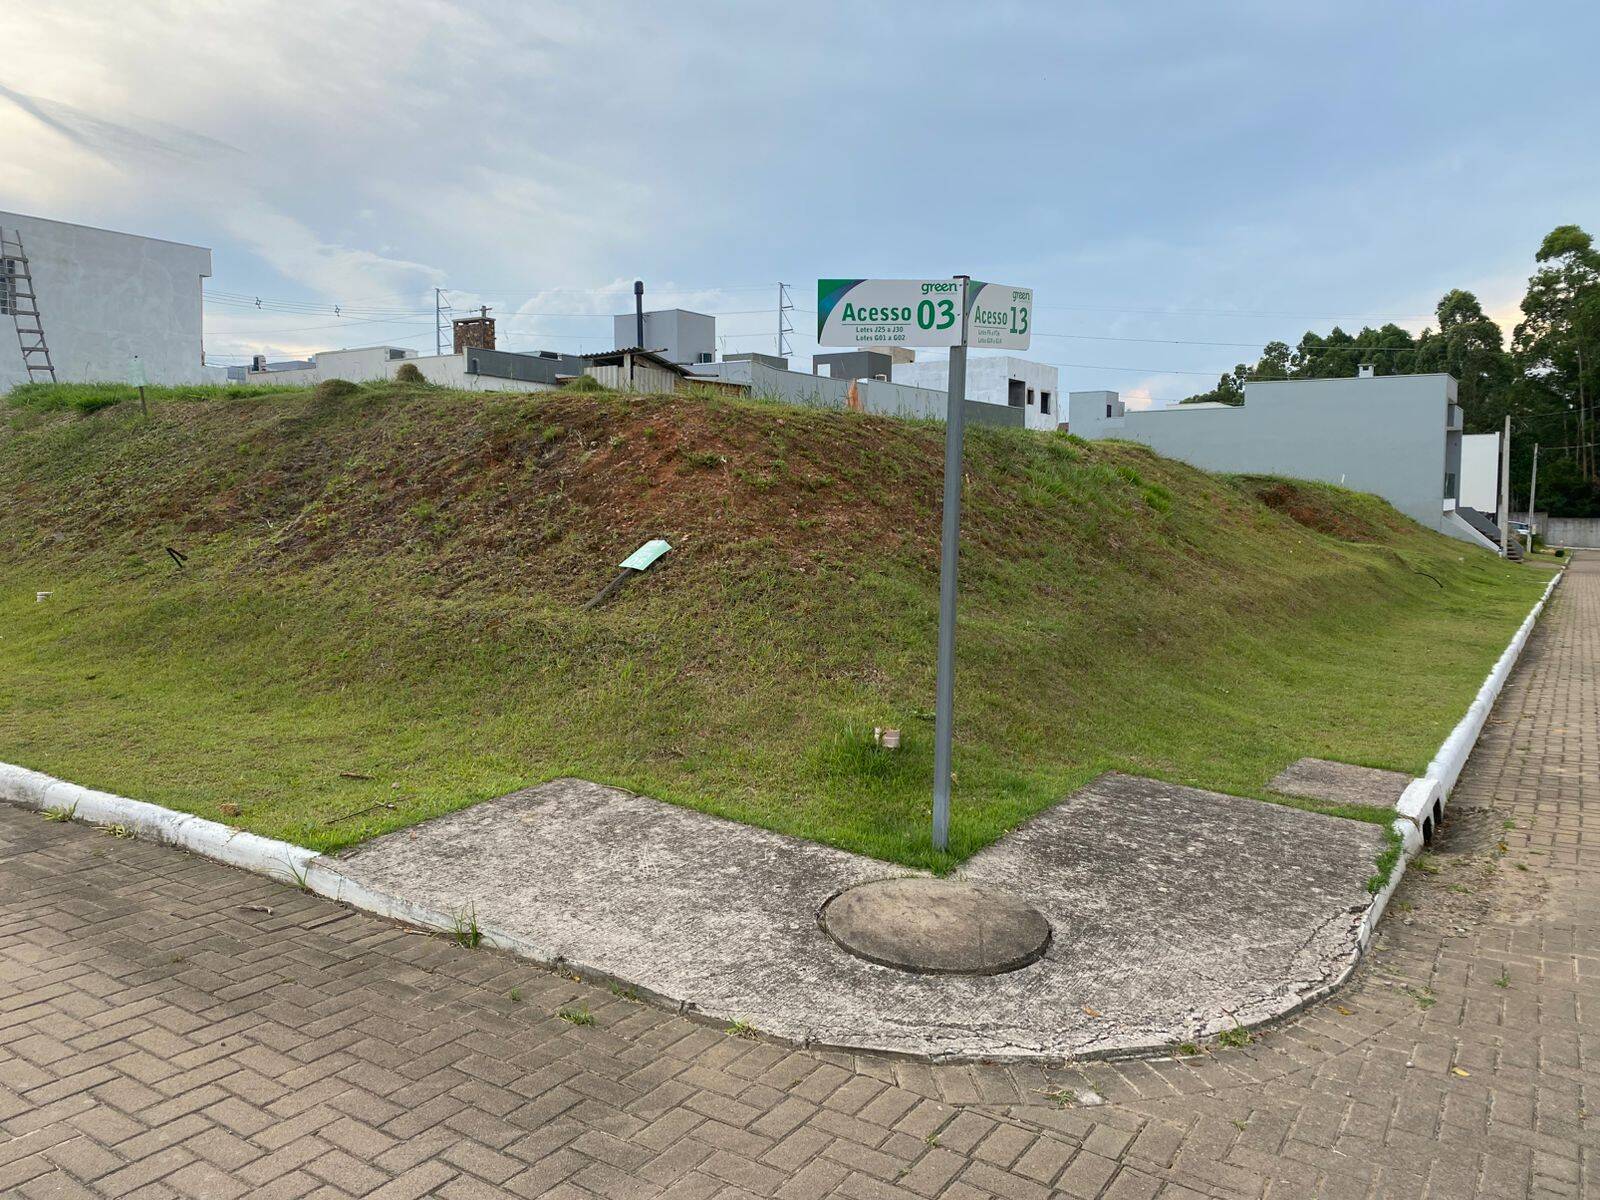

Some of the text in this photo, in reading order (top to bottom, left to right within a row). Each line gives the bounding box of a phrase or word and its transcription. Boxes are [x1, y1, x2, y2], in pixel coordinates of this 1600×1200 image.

[921, 283, 957, 294] green
[1012, 291, 1030, 302] green
[842, 299, 955, 330] Acesso 03
[974, 305, 1028, 335] Acesso 13
